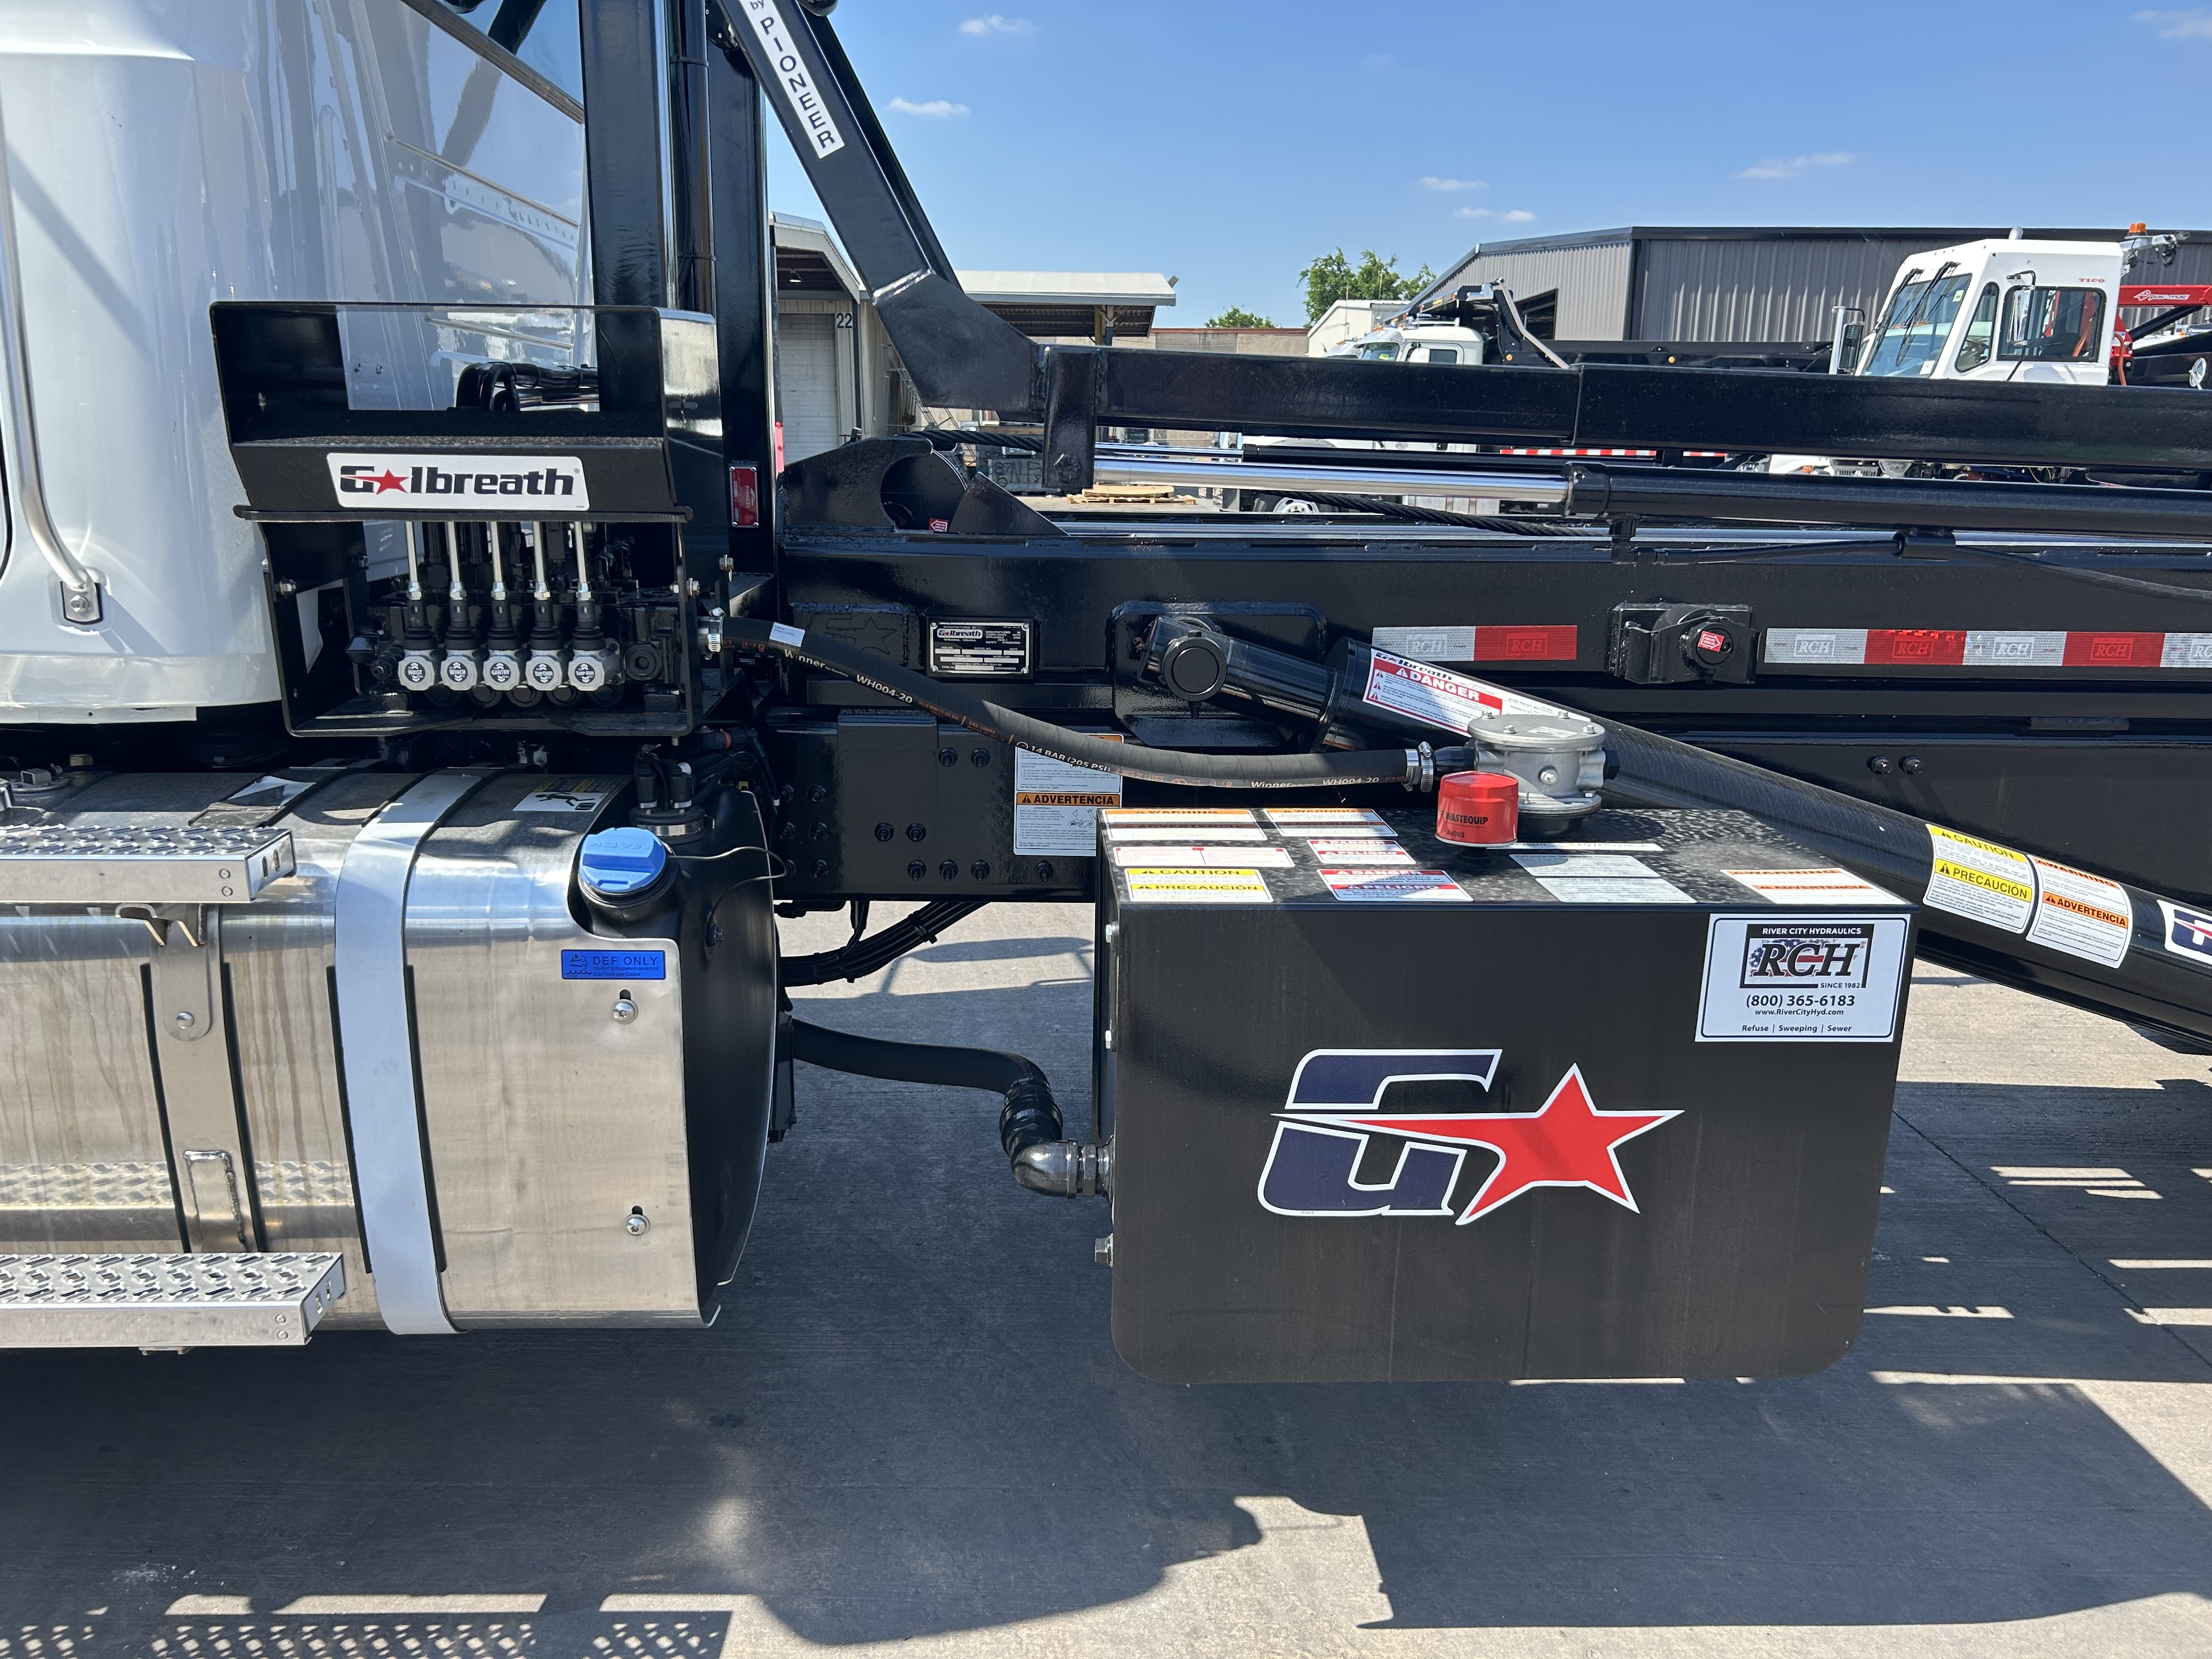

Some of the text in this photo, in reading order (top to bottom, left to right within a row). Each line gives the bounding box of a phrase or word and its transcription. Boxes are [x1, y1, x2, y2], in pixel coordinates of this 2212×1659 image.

[760, 16, 836, 149] PIONEER
[837, 313, 852, 328] 22
[1412, 640, 1445, 652] RCH
[1511, 640, 1544, 652] RCH
[1799, 641, 1831, 653] RCH
[1897, 641, 1929, 654] RCH
[1995, 643, 2029, 656] RCH
[2095, 645, 2129, 657] RCH
[2193, 645, 2212, 657] RC
[784, 648, 825, 668] Winner
[856, 674, 913, 704] WH004-20
[1409, 672, 1479, 701] DANGER
[1031, 745, 1110, 772] 14 BAR (205 PSI)
[1322, 777, 1379, 785] WH004-20
[1034, 794, 1114, 805] ADVERTENCIA
[1446, 812, 1488, 825] WASTEQUIP
[1954, 834, 2014, 859] CAUTION
[1953, 867, 2027, 899] PRECAUCIÓN
[2057, 898, 2126, 927] ADVERTENCIA
[593, 956, 658, 966] DEF ONLY
[1753, 943, 1860, 977] RCH
[1746, 995, 1855, 1007] (800) 365-6183
